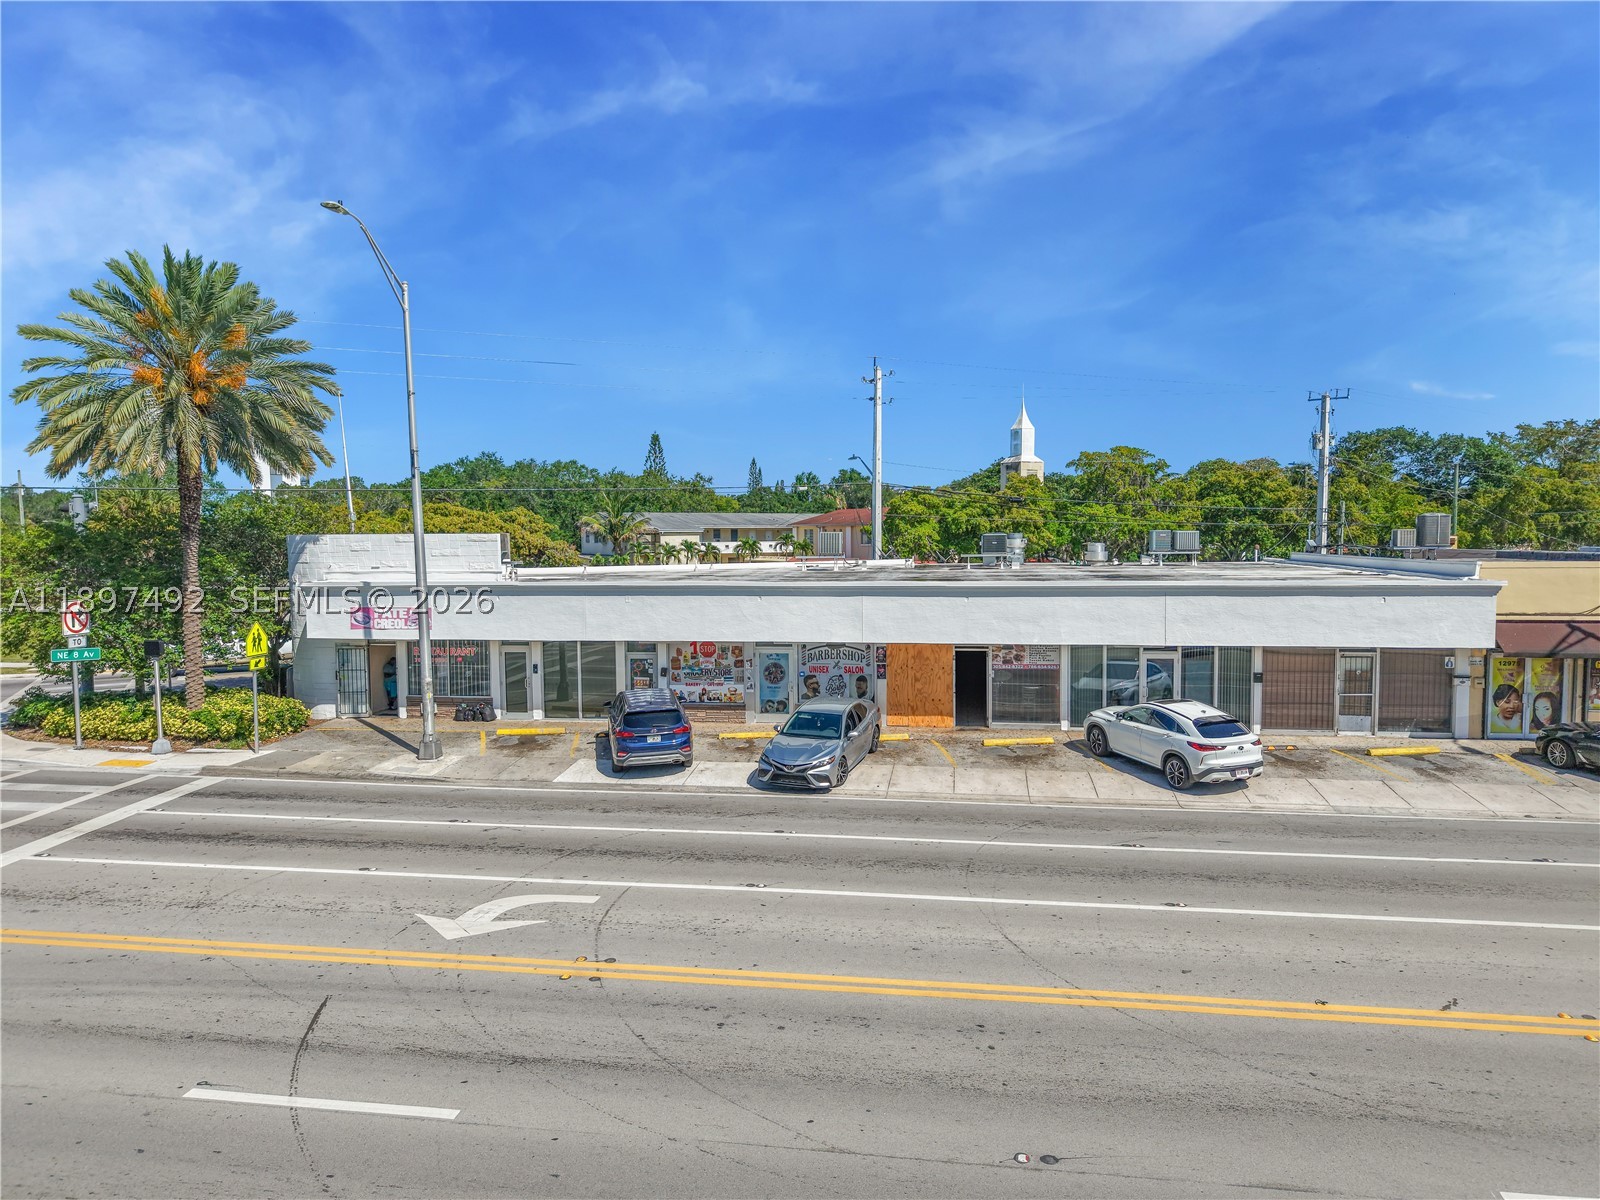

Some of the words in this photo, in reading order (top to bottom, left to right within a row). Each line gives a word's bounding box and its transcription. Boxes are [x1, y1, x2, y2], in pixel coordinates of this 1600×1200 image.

[374, 618, 414, 629] CREOL
[72, 638, 82, 646] TO
[413, 647, 476, 656] RTAURANT
[689, 641, 698, 654] 1
[700, 645, 716, 653] STOP
[57, 651, 69, 659] NE
[83, 650, 94, 658] Av
[807, 648, 866, 663] BARBERSHOP
[713, 668, 733, 677] STORE
[808, 665, 829, 674] UNISEX
[843, 665, 865, 674] SALON
